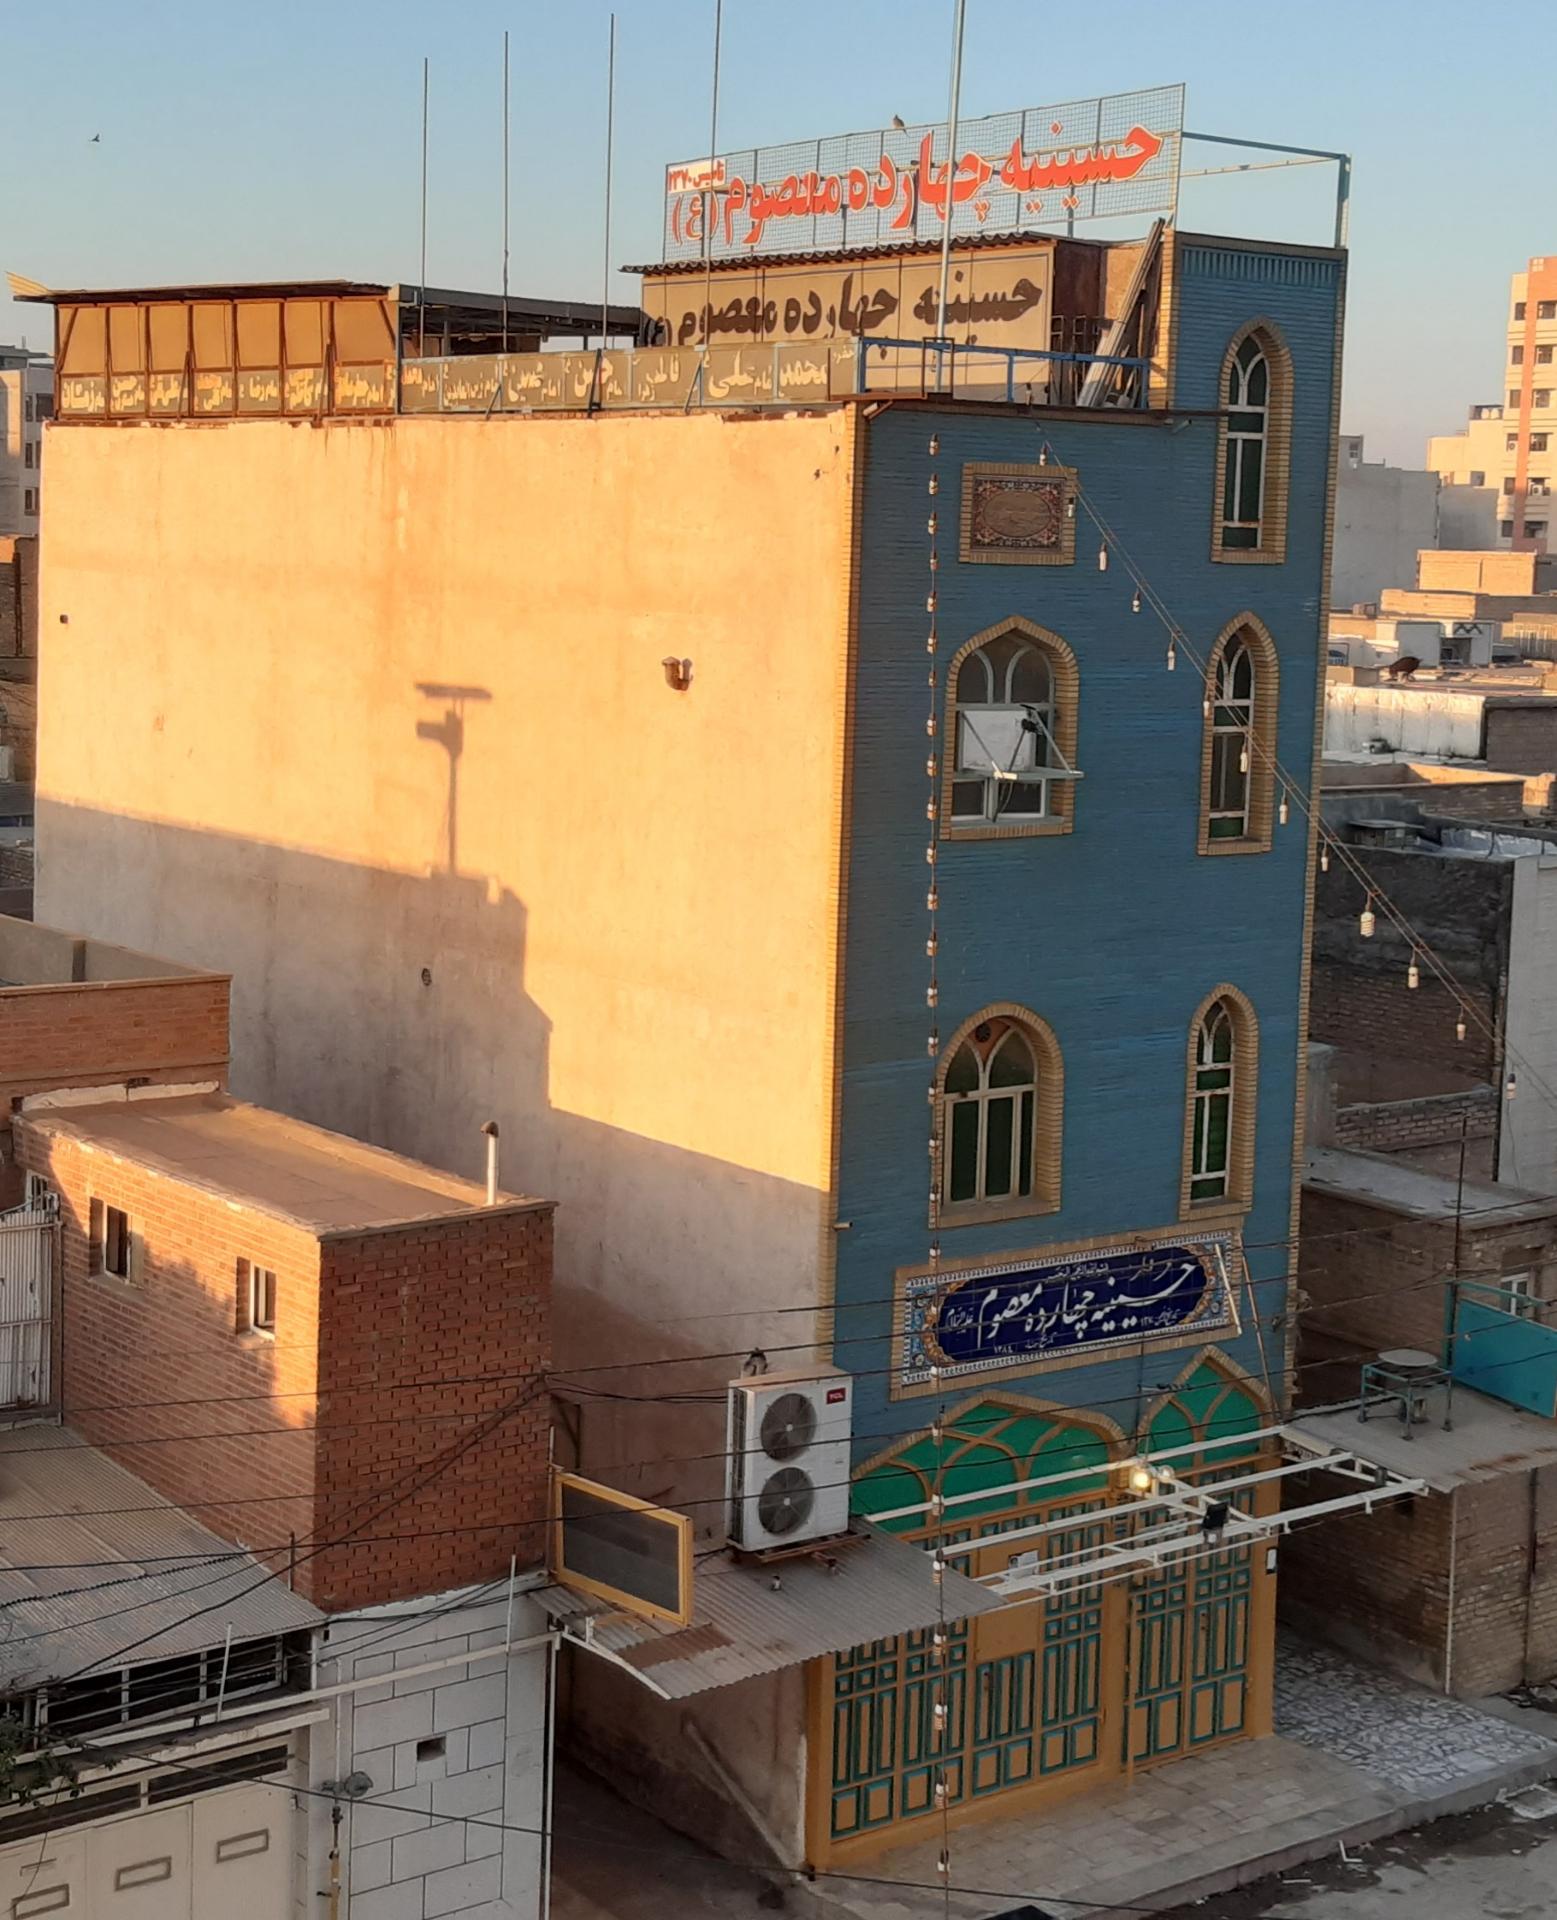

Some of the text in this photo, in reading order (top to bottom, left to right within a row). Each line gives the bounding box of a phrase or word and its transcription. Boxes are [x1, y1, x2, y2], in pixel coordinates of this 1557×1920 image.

[847, 130, 994, 231] چهارده
[1000, 123, 1163, 214] حسینیه
[724, 169, 843, 247] معصوم
[678, 296, 778, 346] معصوم
[913, 270, 1043, 346] حسینیه
[977, 1283, 1043, 1350] معصوم
[1024, 1281, 1096, 1340] چهارده
[1090, 1263, 1198, 1333] حسینیه
